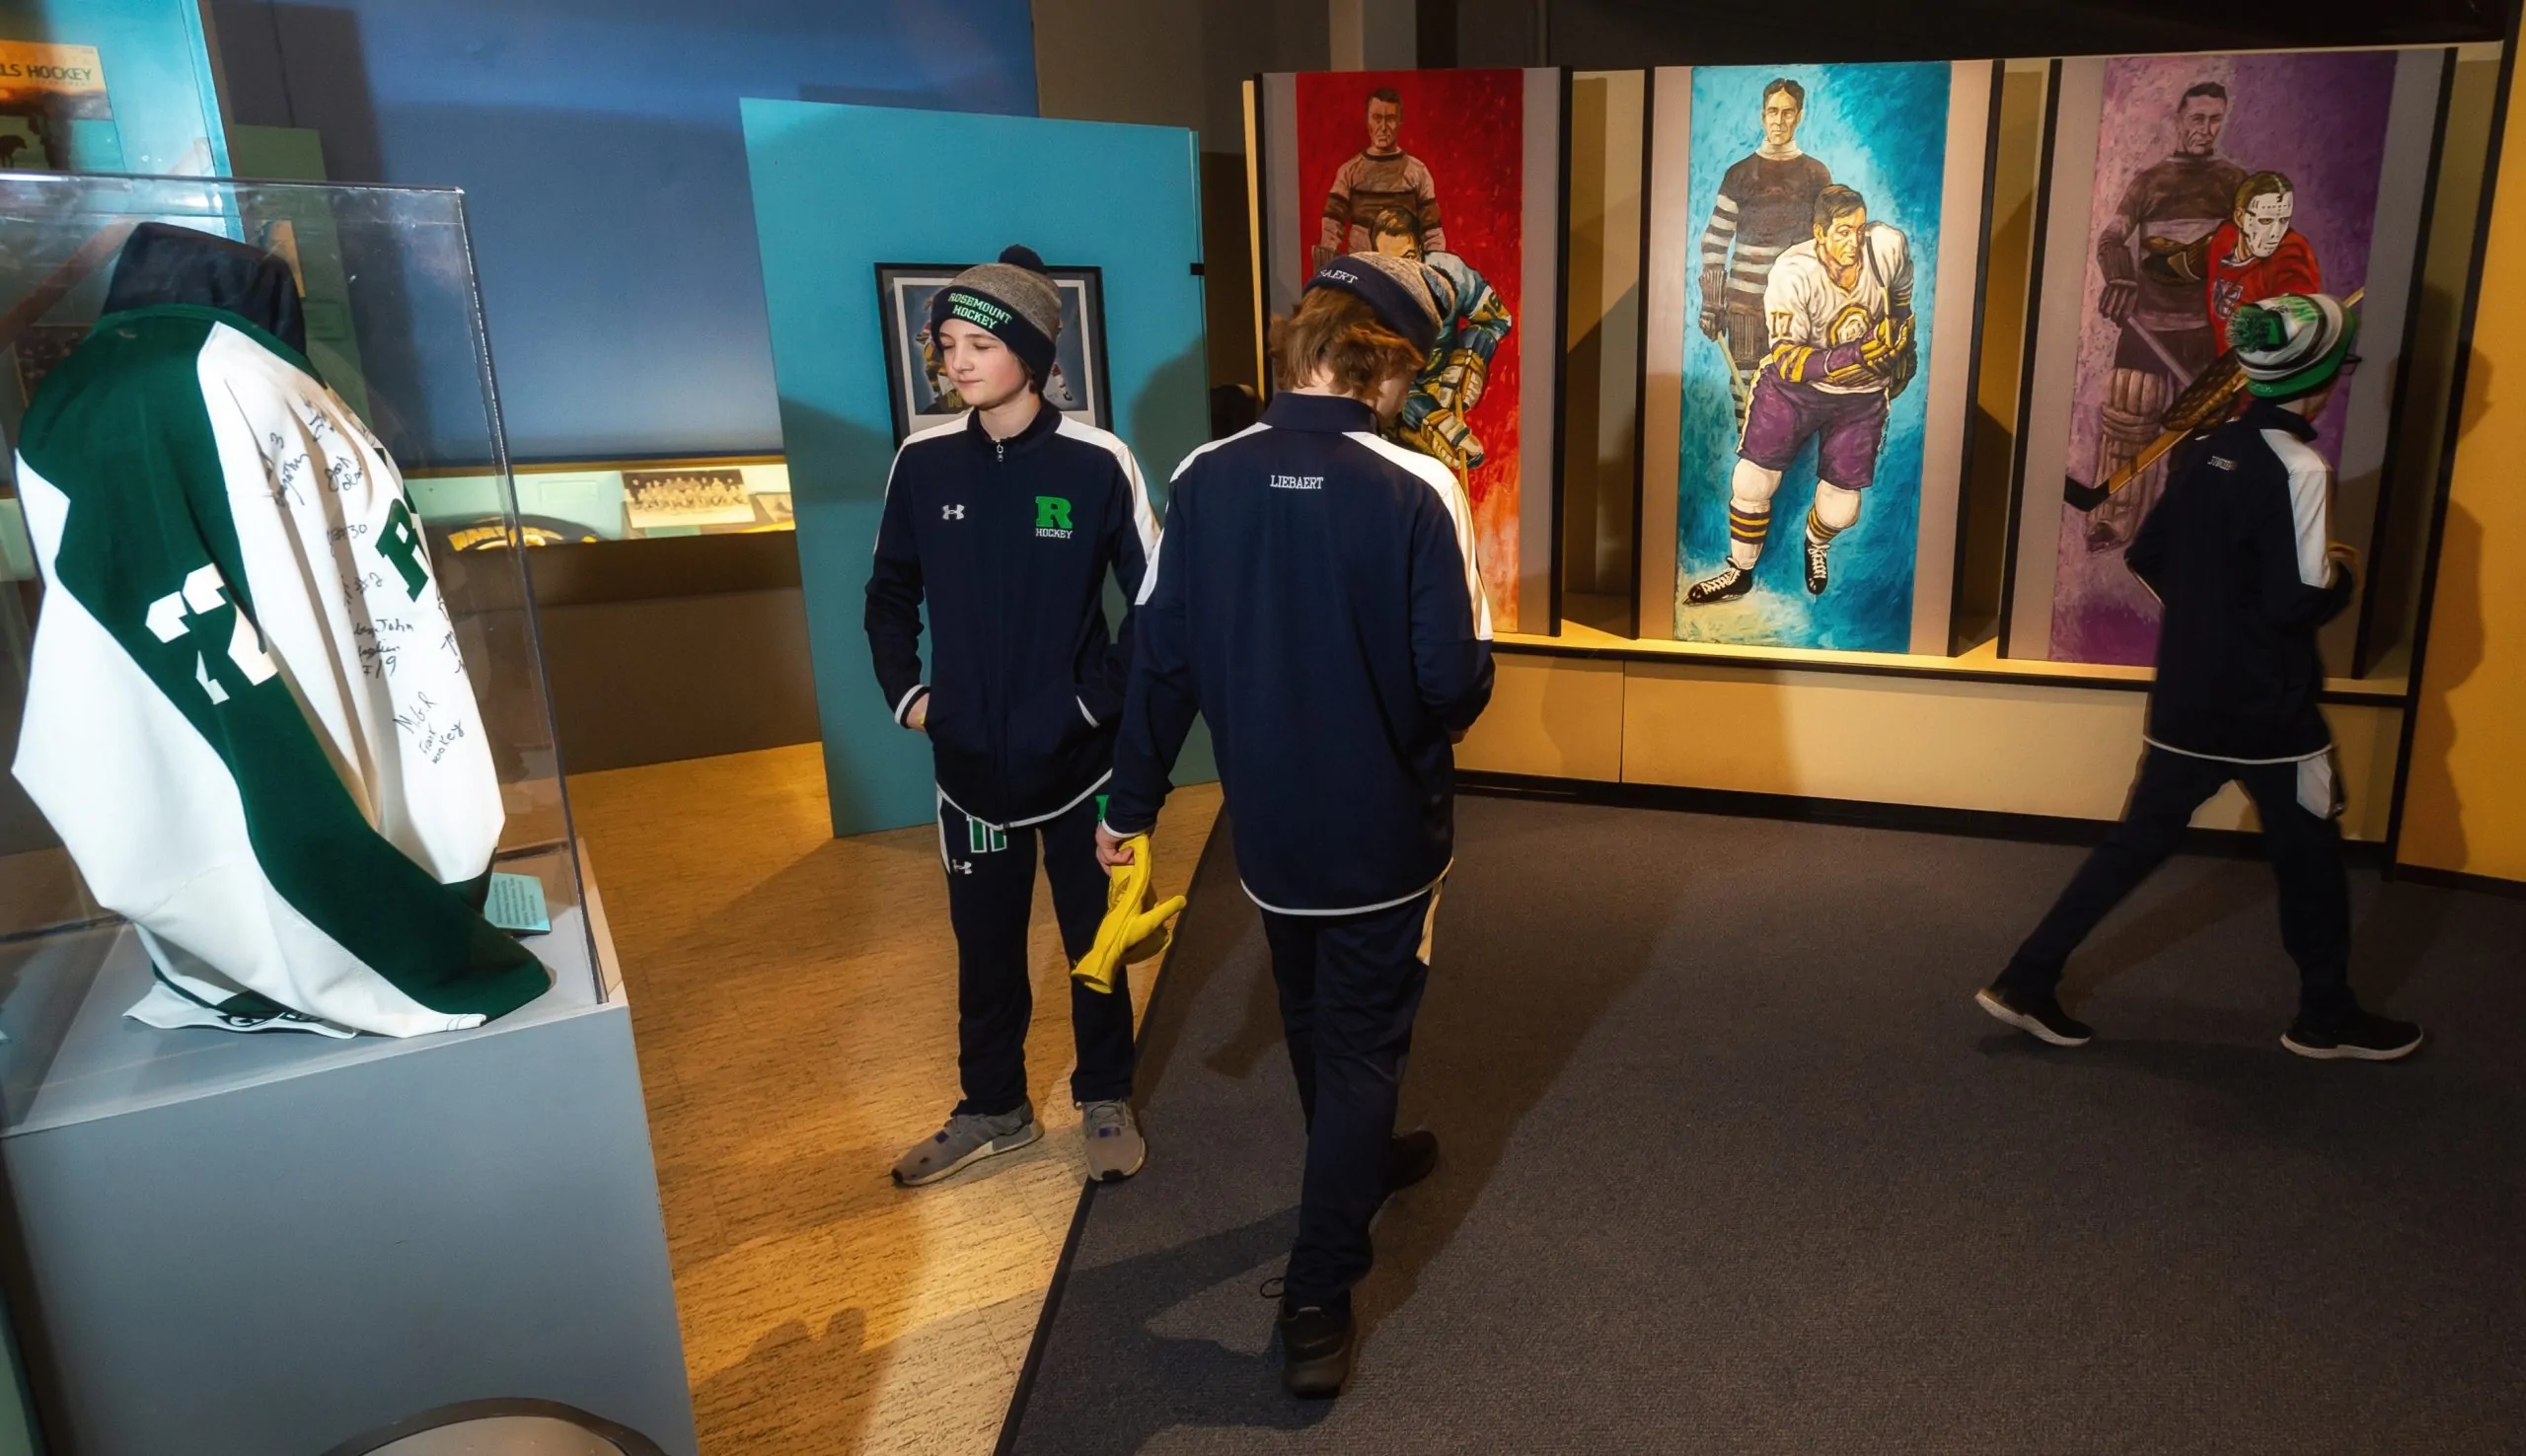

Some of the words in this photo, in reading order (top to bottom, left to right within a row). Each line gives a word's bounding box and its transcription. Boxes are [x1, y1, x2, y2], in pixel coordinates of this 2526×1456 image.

[27, 64, 92, 81] HOCKEY
[948, 293, 1012, 325] ROSEMOUNT
[952, 305, 999, 329] HOCKEY
[1770, 311, 1794, 338] 17
[1270, 474, 1324, 489] LIEBAERT
[1035, 495, 1073, 529] R
[1036, 528, 1073, 539] HOCKEY
